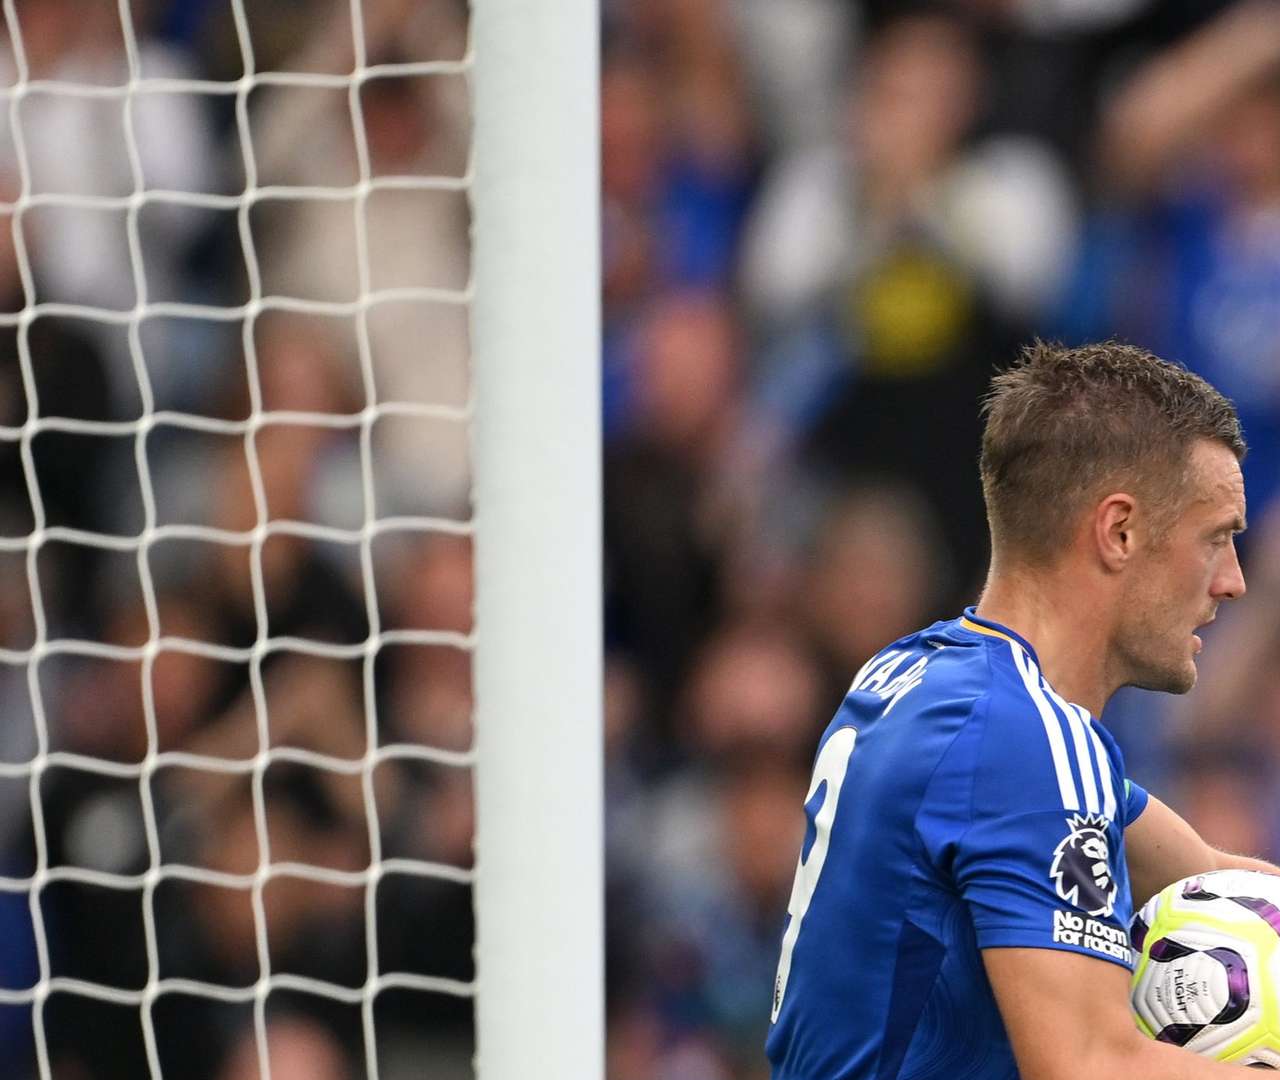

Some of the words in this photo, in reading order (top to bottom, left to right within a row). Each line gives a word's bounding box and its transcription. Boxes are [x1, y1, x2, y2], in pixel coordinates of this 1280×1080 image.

[1053, 910, 1084, 931] No
[1085, 919, 1128, 947] room
[1084, 934, 1133, 965] racism
[1174, 968, 1188, 1014] FLIGHT
